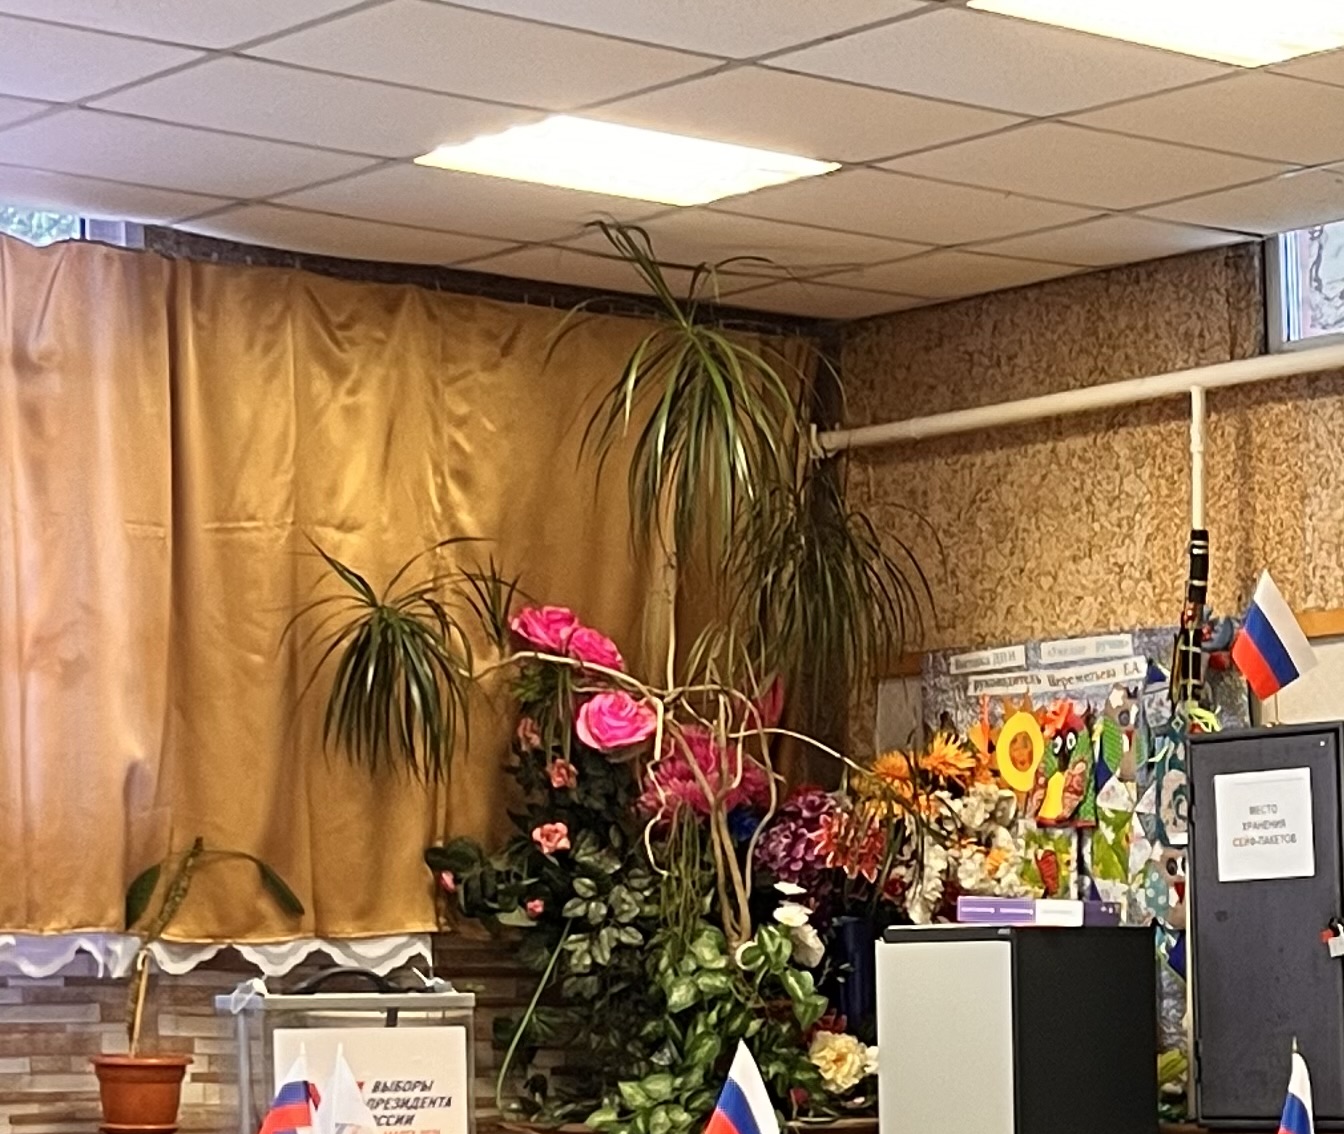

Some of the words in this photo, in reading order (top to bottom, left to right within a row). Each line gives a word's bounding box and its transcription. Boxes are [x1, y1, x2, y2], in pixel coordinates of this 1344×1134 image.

[1249, 803, 1278, 815] МЕСТО
[1242, 818, 1286, 831] ХРАНЕНИЯ
[371, 1080, 434, 1094] ВЫБОРЫ
[366, 1096, 452, 1111] ПРЕЗИДЕНТА
